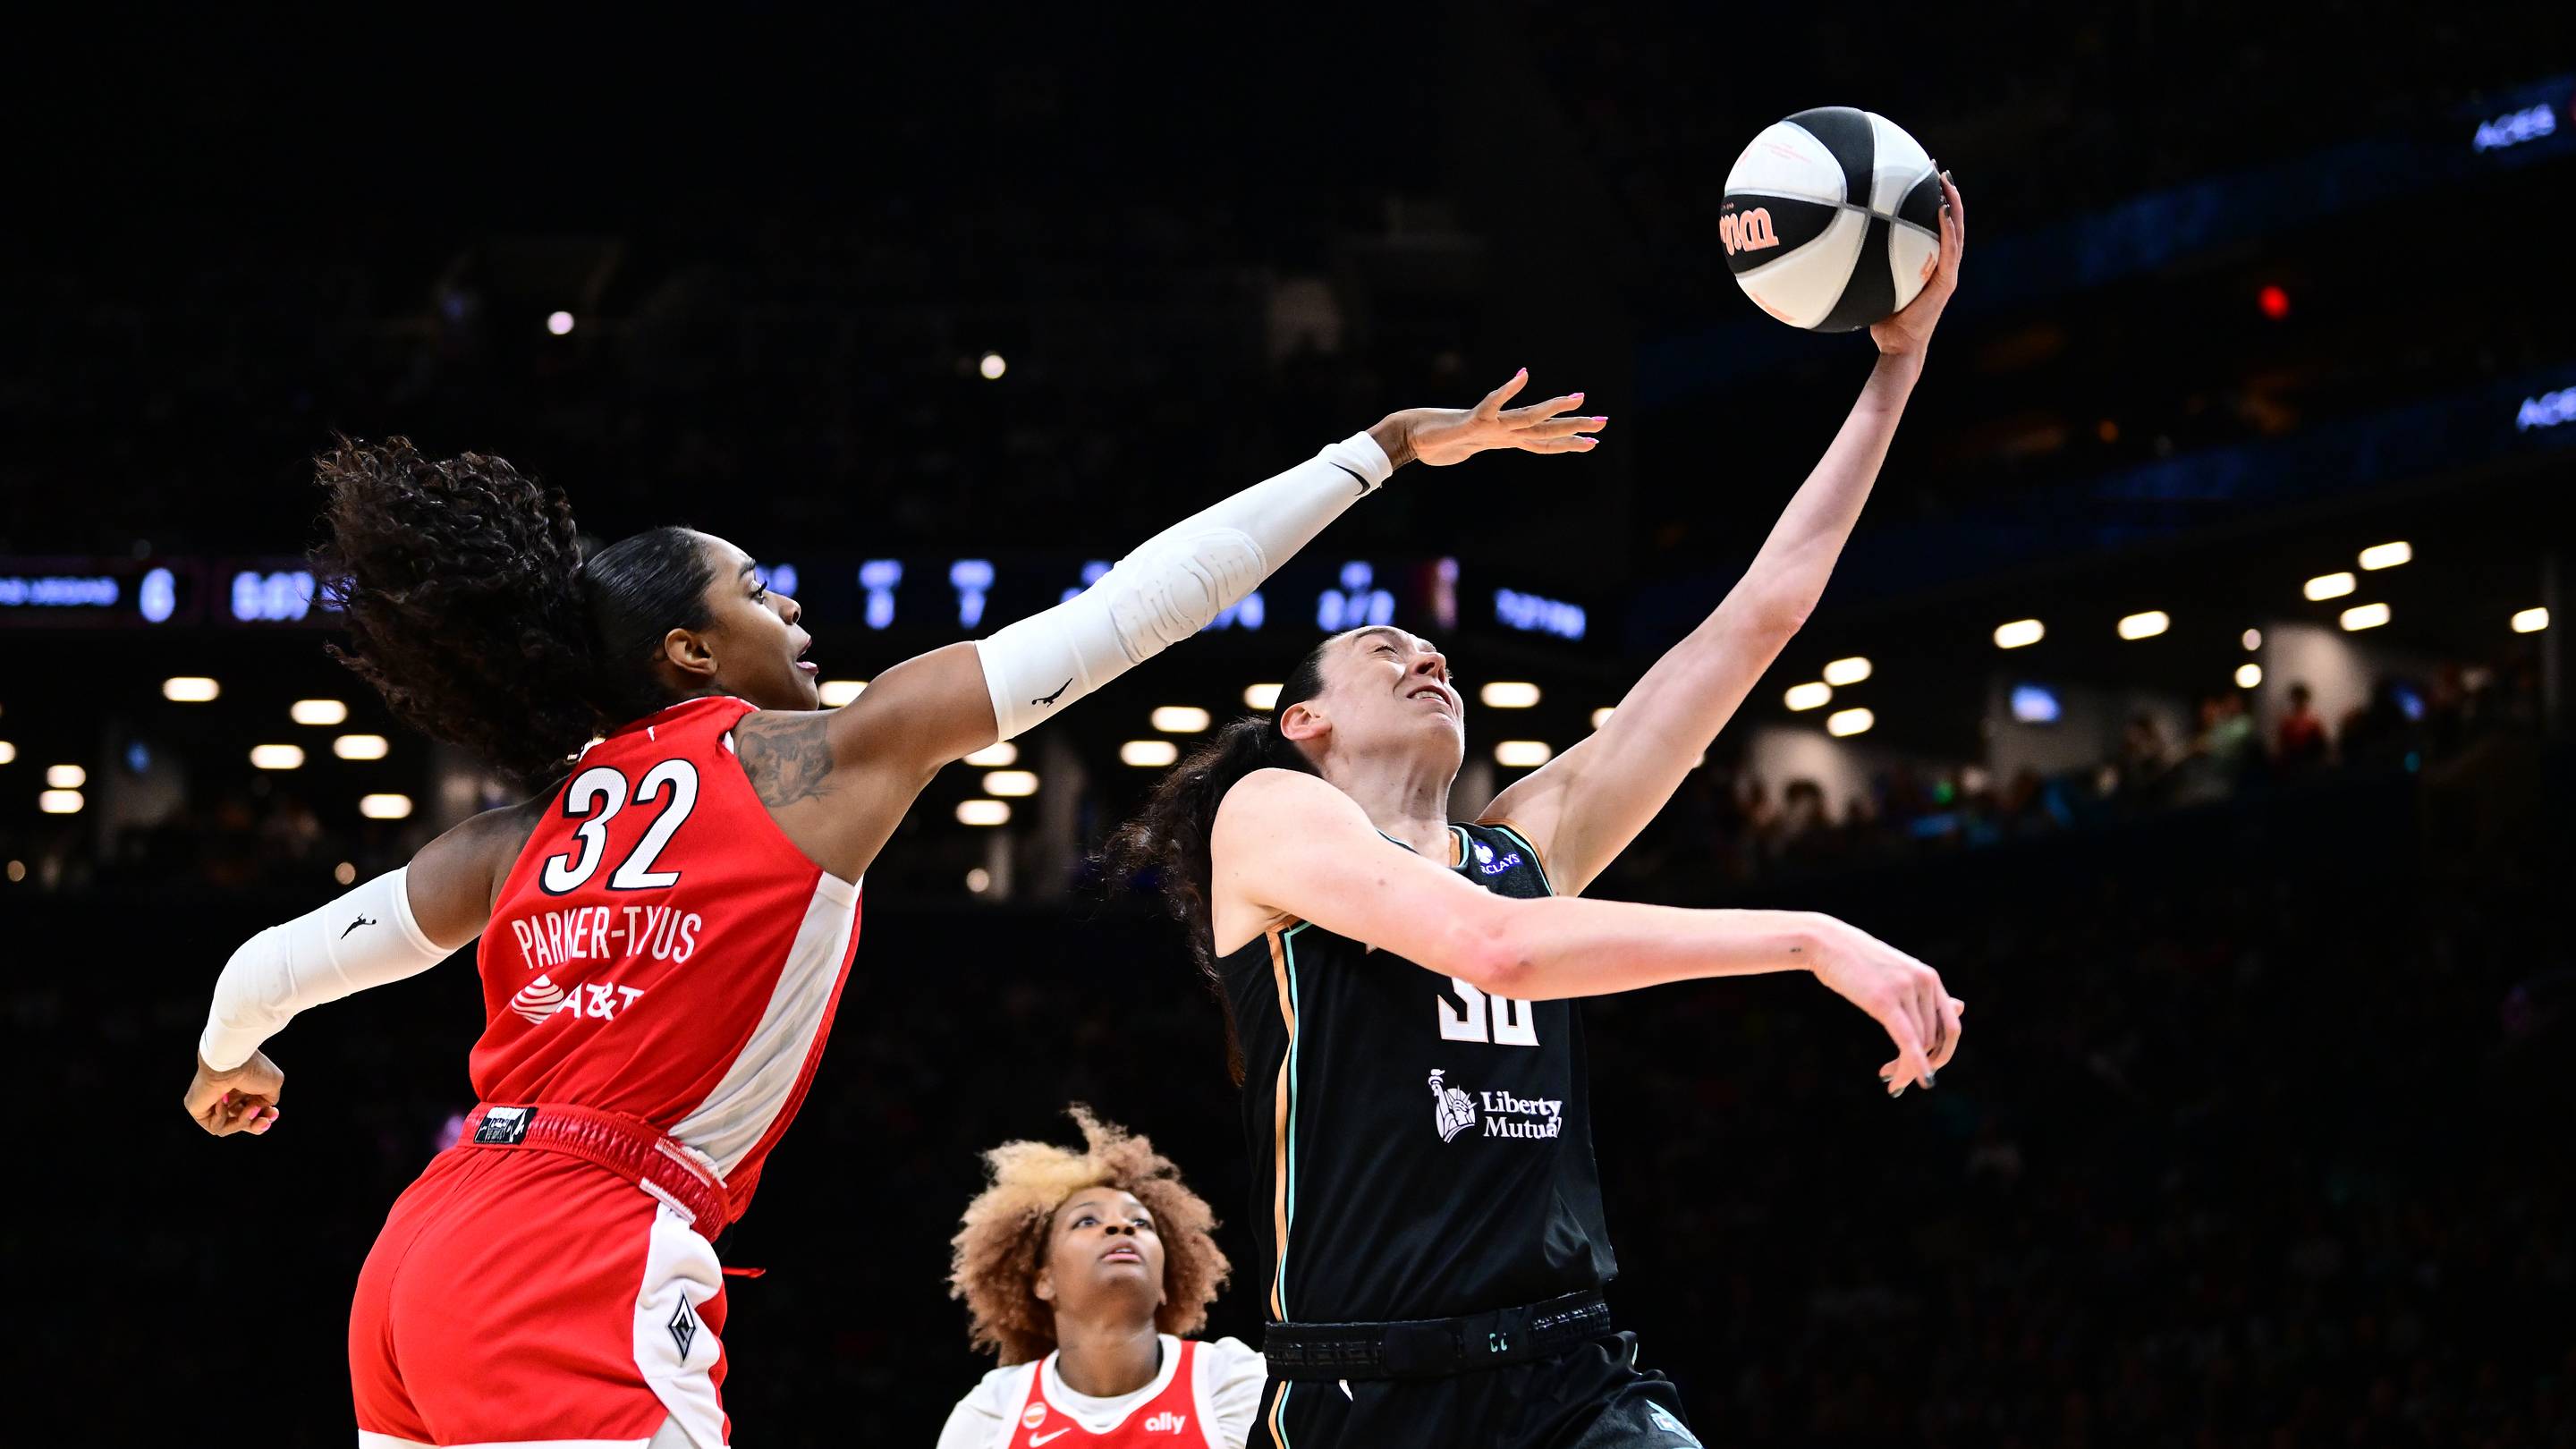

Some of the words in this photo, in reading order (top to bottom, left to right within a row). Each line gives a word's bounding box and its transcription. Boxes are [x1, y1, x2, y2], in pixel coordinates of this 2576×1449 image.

[539, 758, 699, 896] 32
[511, 905, 702, 970] PARKER-TYUS
[1479, 1090, 1563, 1123] Liberty
[1144, 1411, 1186, 1435] ally
